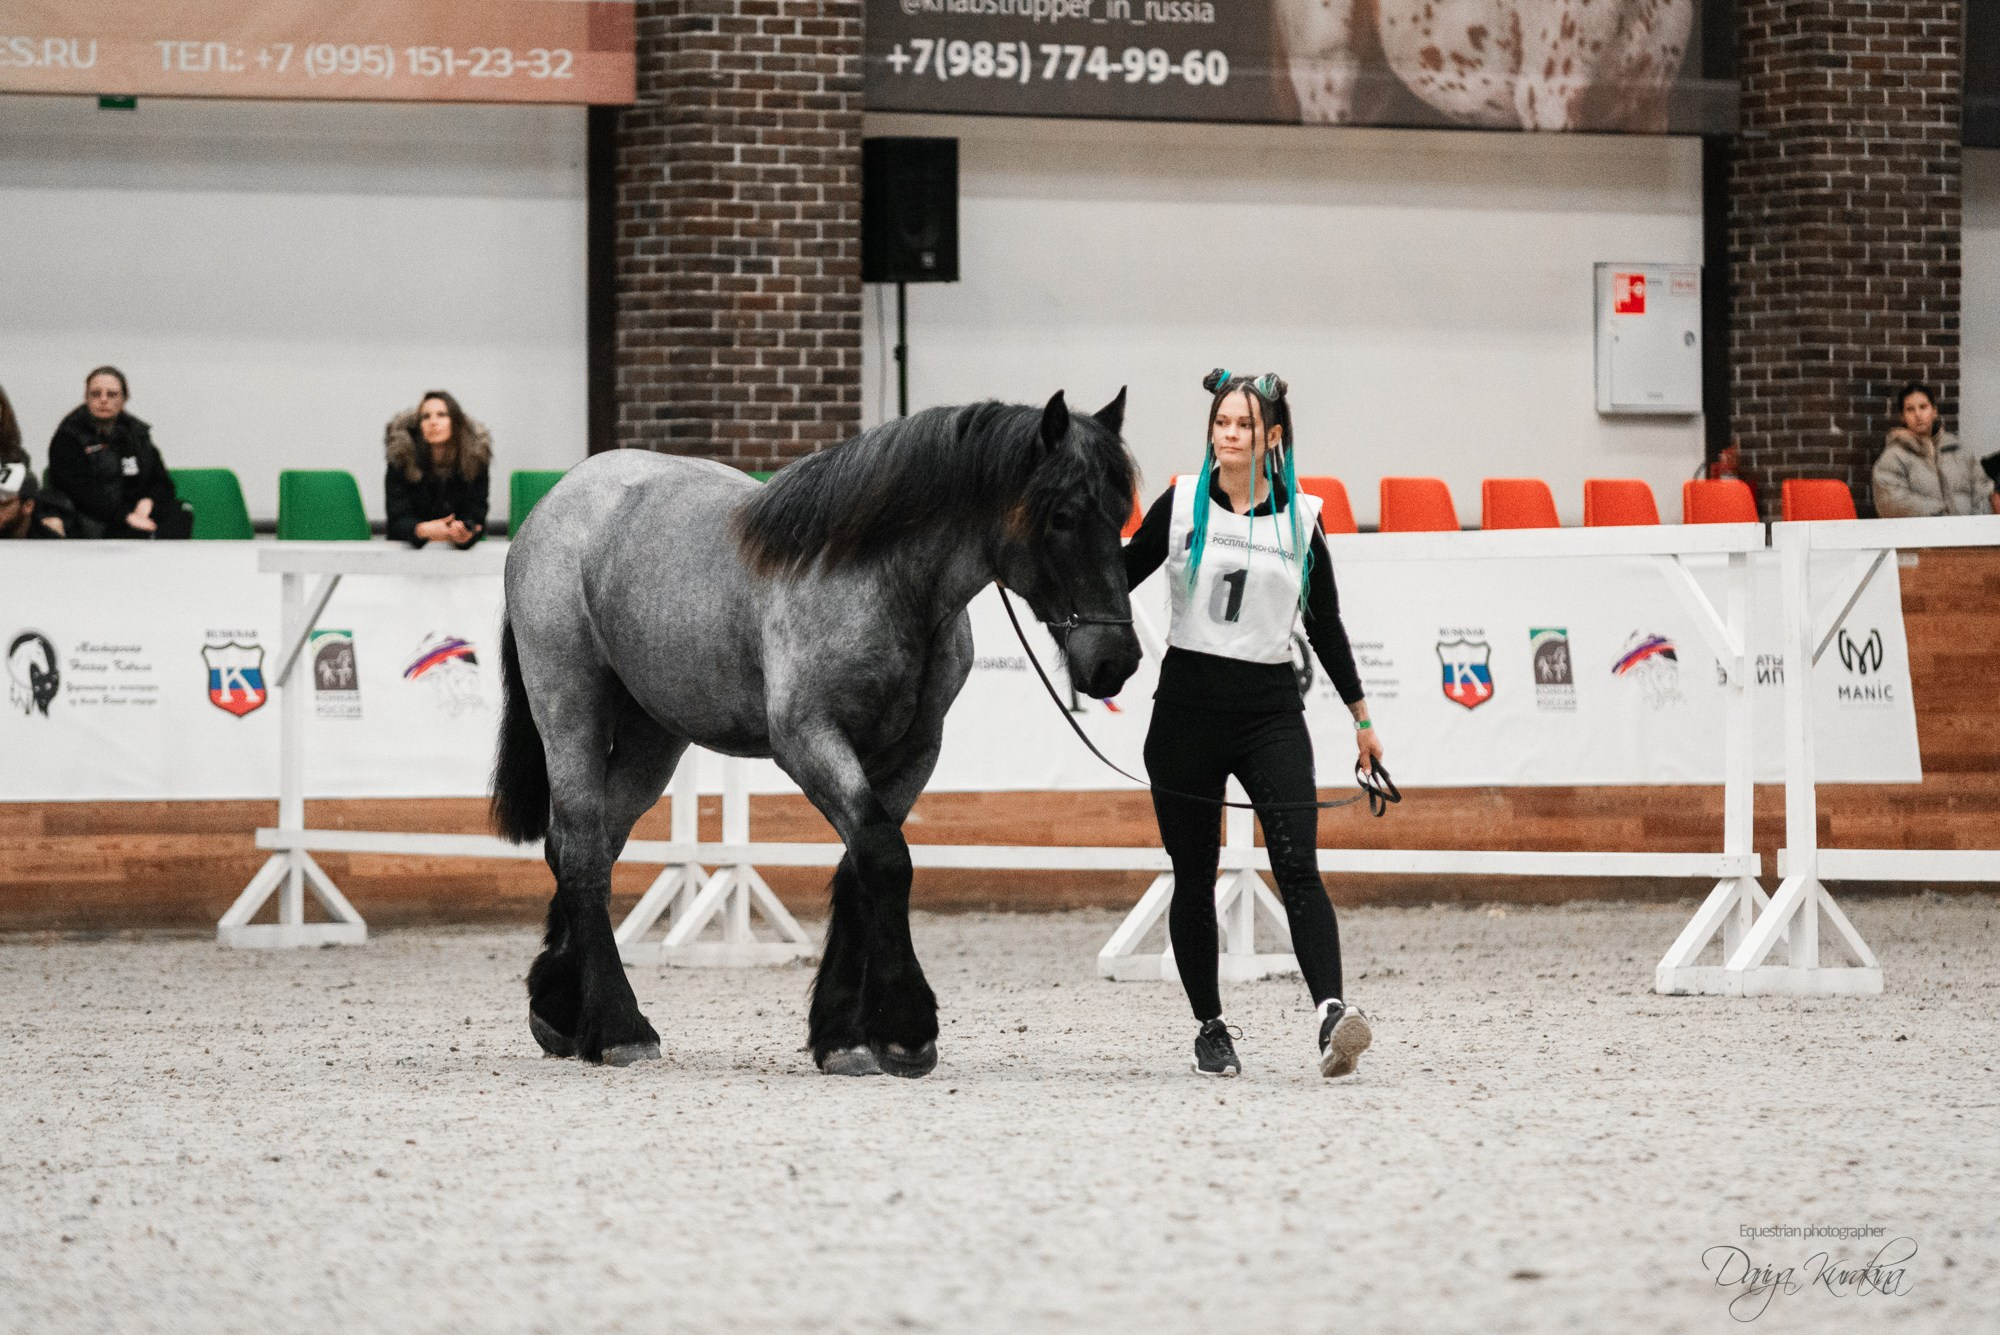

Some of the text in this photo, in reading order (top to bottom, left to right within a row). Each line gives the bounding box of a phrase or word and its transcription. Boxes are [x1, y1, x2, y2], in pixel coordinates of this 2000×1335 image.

[155, 40, 574, 80] ТЕЛ.: +7 (995) 151-23-32
[886, 37, 1230, 85] +7(985) 774-99-60
[1223, 567, 1249, 623] 1
